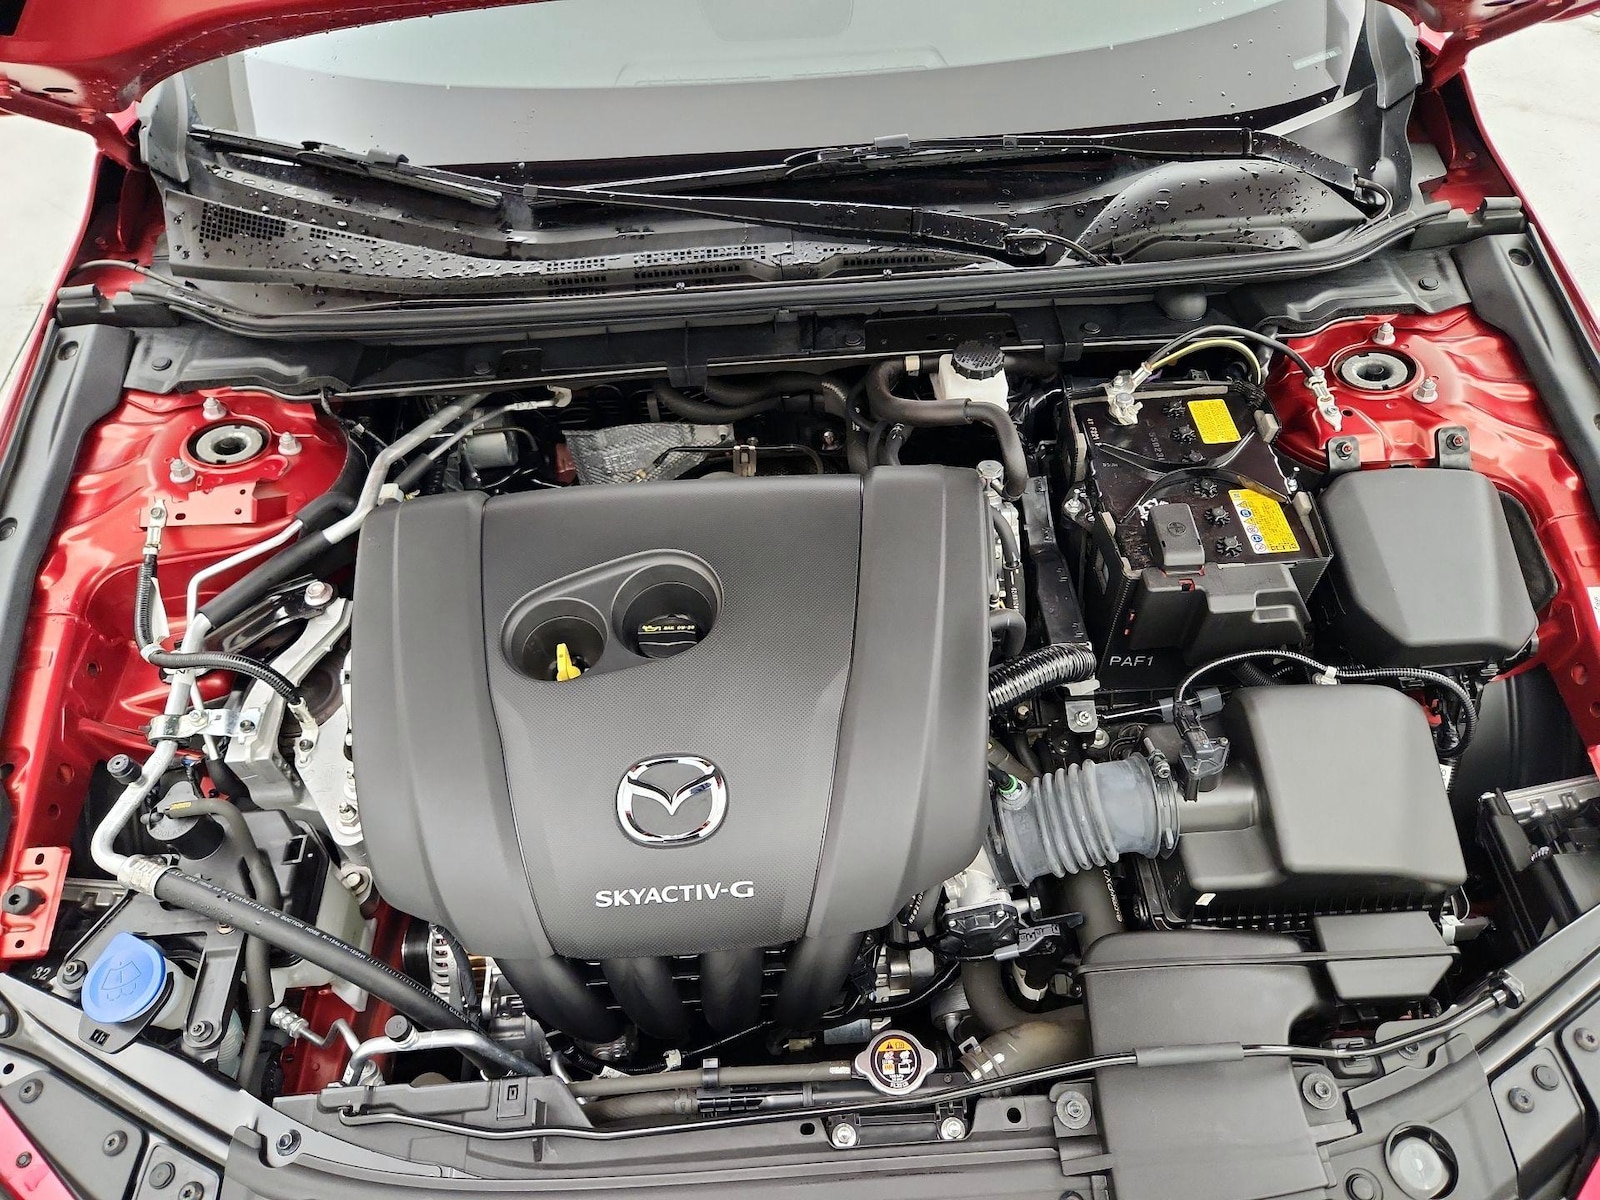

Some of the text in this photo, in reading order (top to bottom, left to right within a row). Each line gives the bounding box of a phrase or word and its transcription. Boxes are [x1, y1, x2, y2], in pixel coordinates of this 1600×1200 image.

[1109, 655, 1154, 667] PAF1
[595, 880, 755, 908] SKYACTIV-G
[226, 891, 268, 913] Flexbarrier
[280, 915, 305, 929] SUCTION
[304, 926, 321, 937] HOSE
[31, 966, 52, 980] 32
